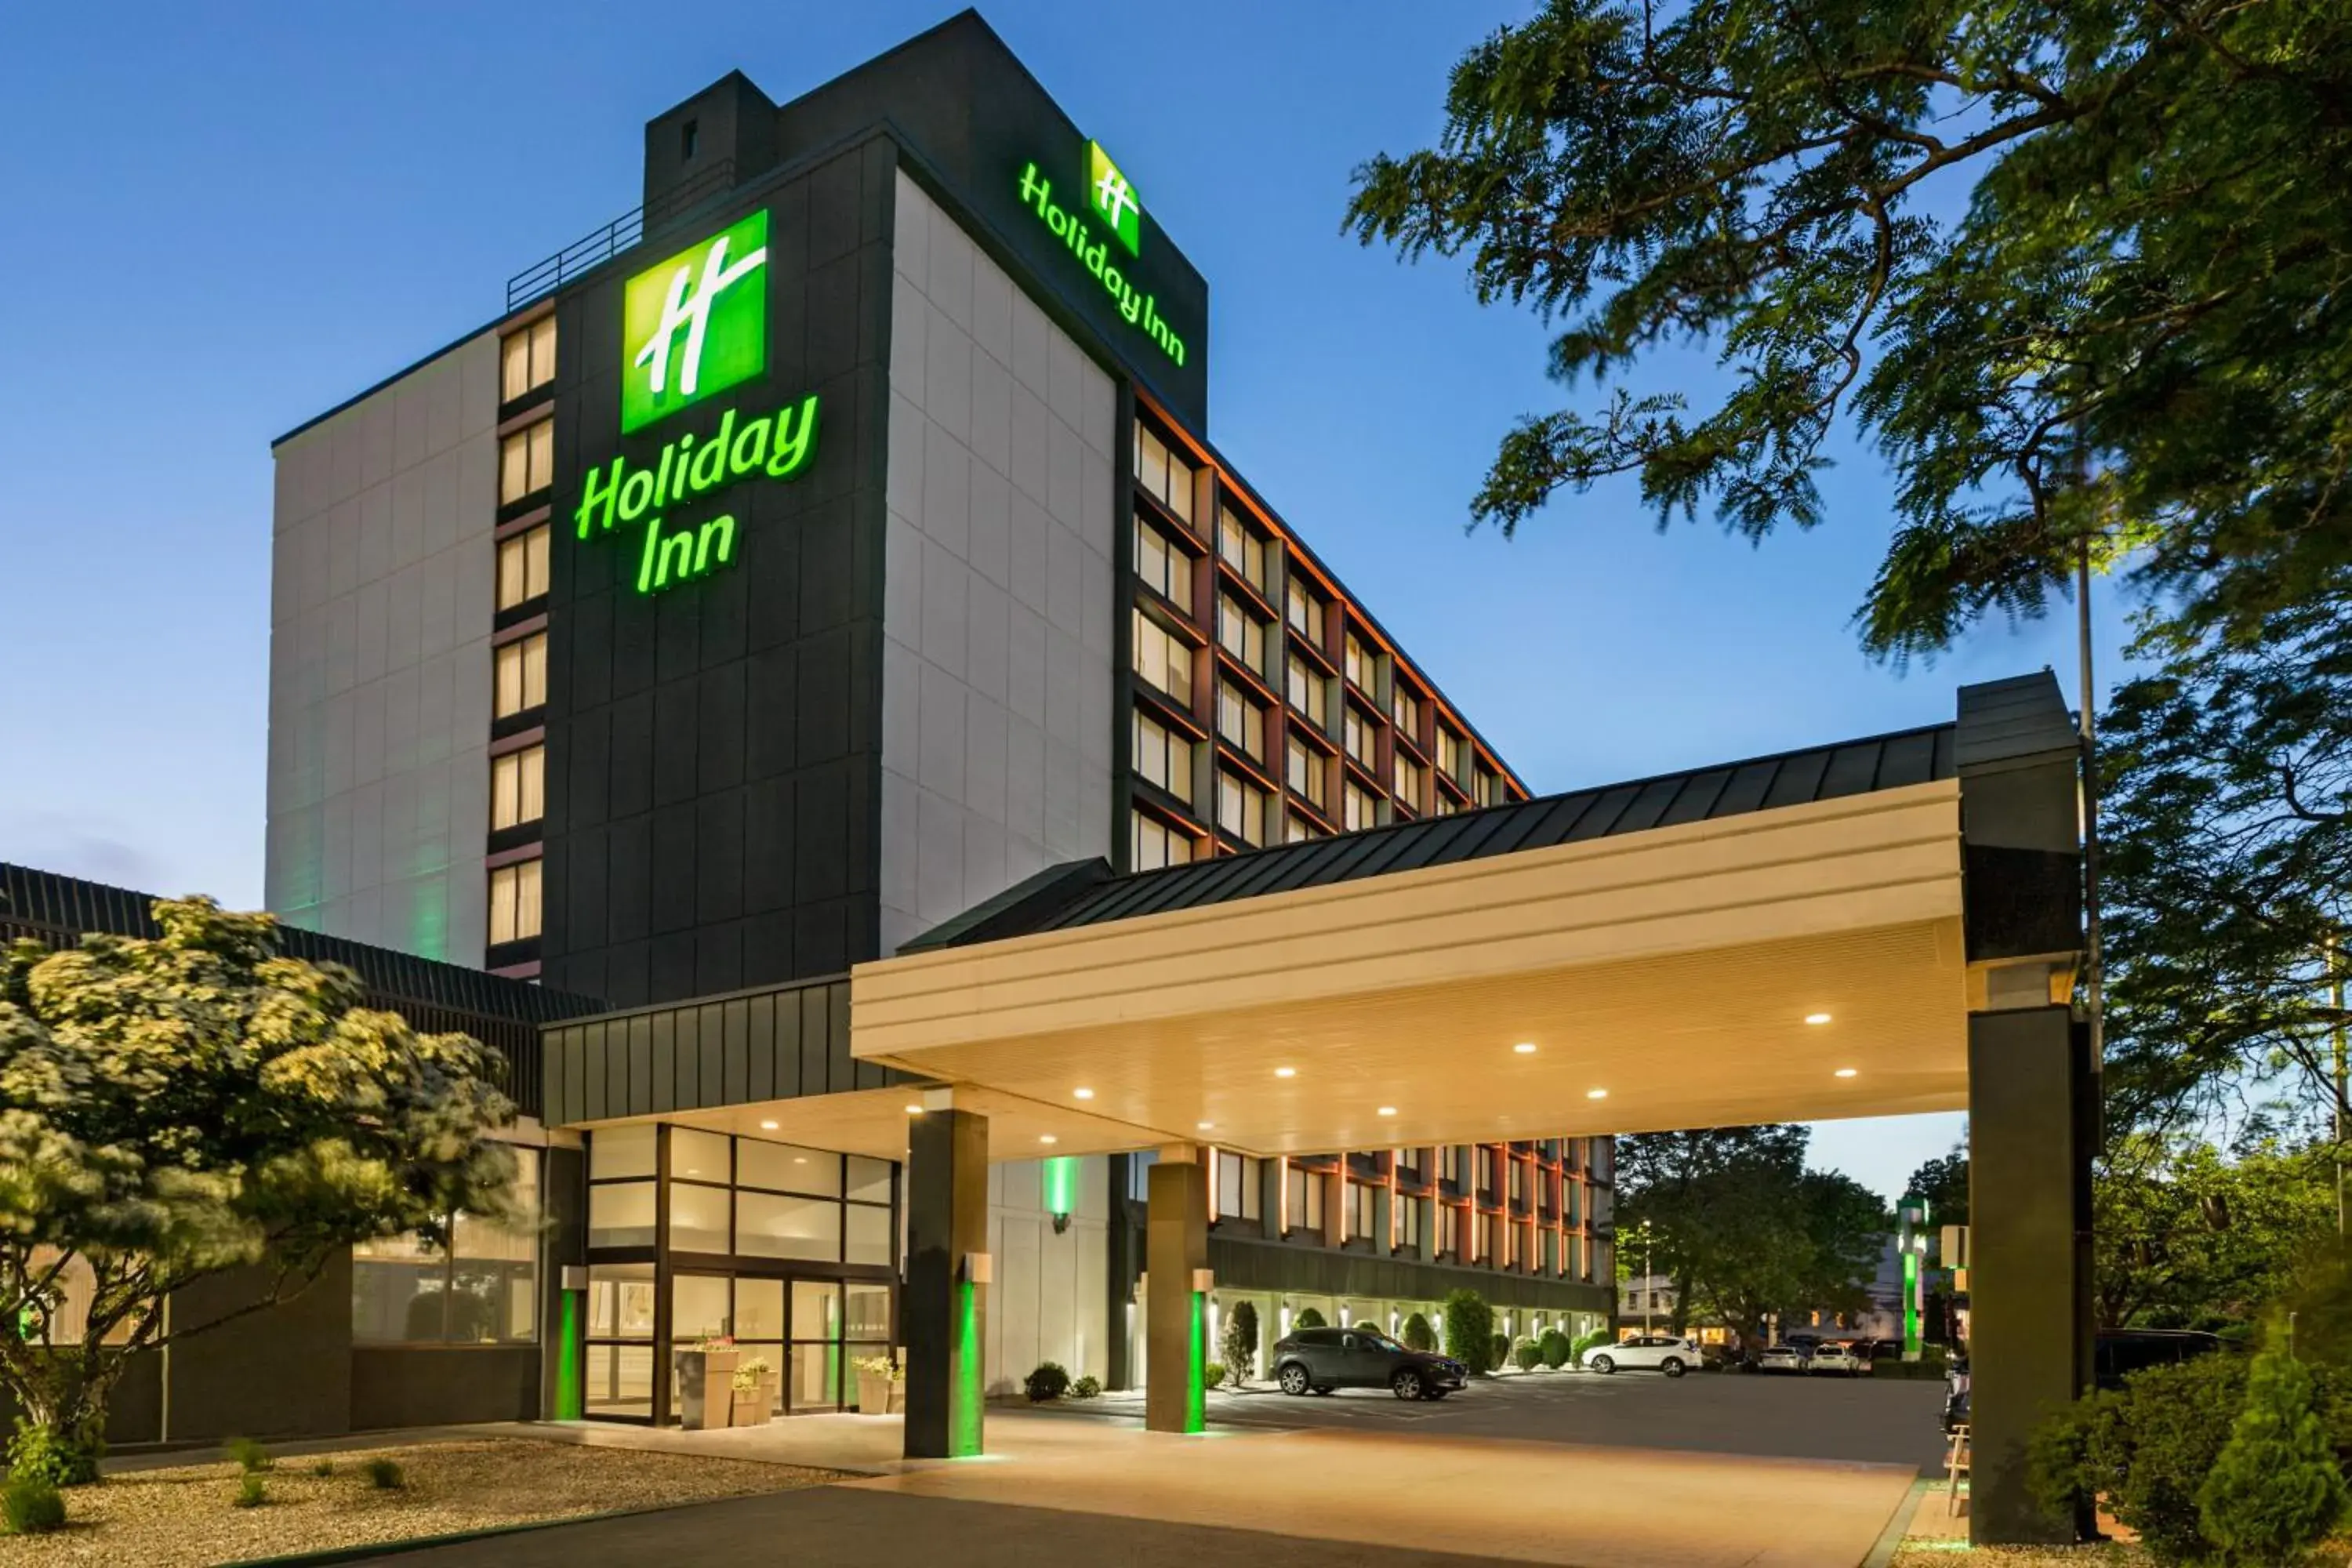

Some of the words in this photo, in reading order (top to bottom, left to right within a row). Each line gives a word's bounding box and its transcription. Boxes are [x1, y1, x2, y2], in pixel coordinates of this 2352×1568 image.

[1020, 162, 1141, 323] Holiday
[1145, 295, 1185, 367] Inn
[1096, 169, 1139, 230] H
[635, 236, 767, 396] H
[575, 396, 818, 539] Holiday
[638, 514, 734, 593] Inn
